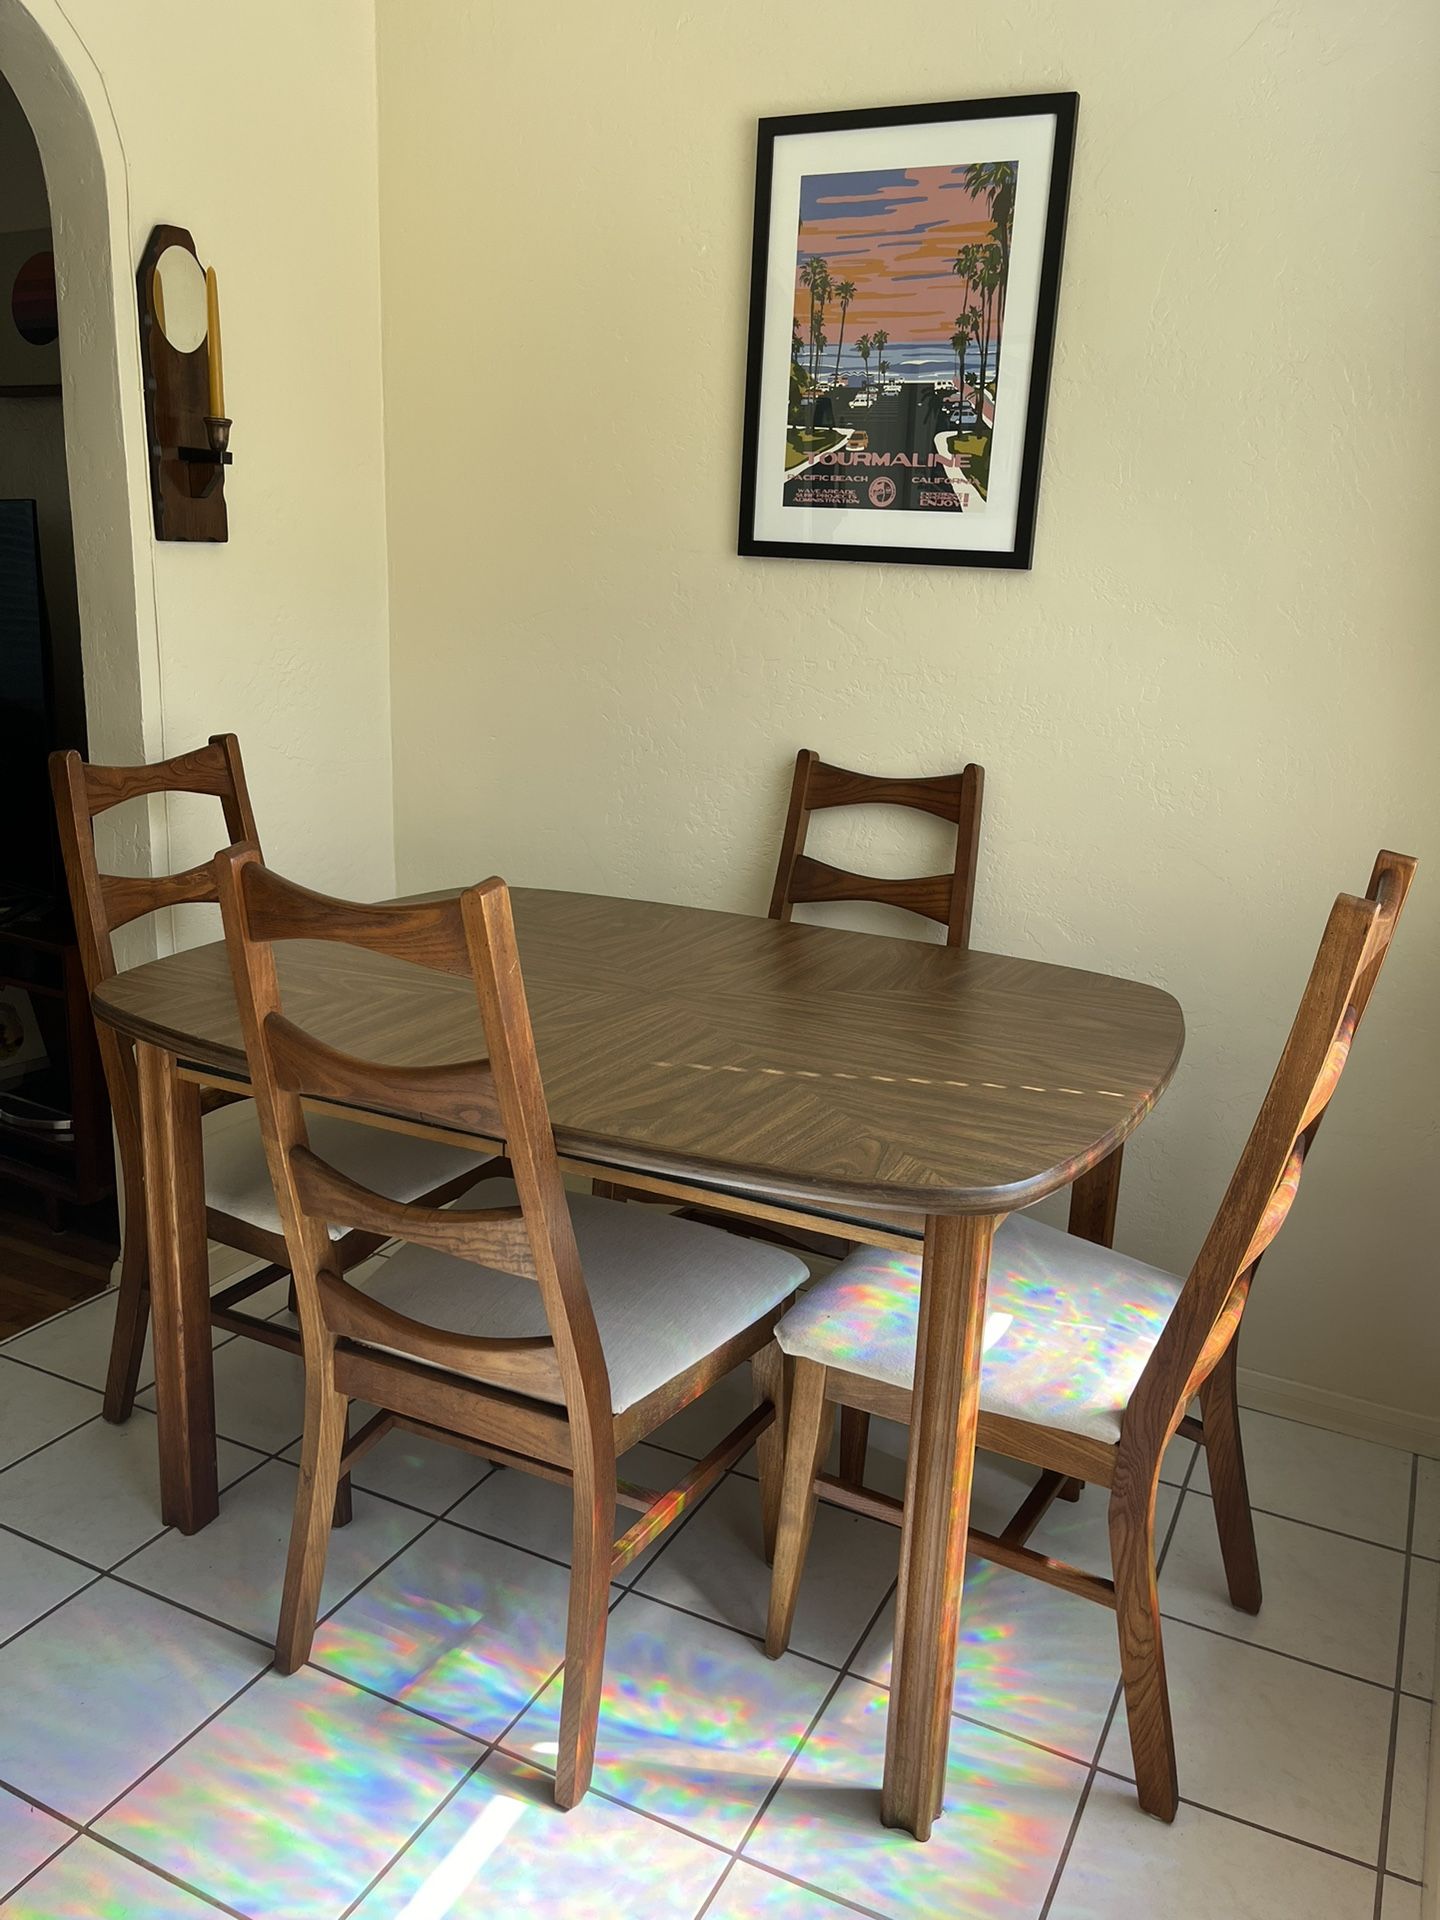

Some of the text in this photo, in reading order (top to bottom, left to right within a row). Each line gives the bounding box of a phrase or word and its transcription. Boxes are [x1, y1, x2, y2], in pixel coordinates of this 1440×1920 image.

[804, 451, 971, 468] TOURMALINE
[830, 474, 869, 482] BEACH
[911, 476, 981, 485] CALIFORNIA
